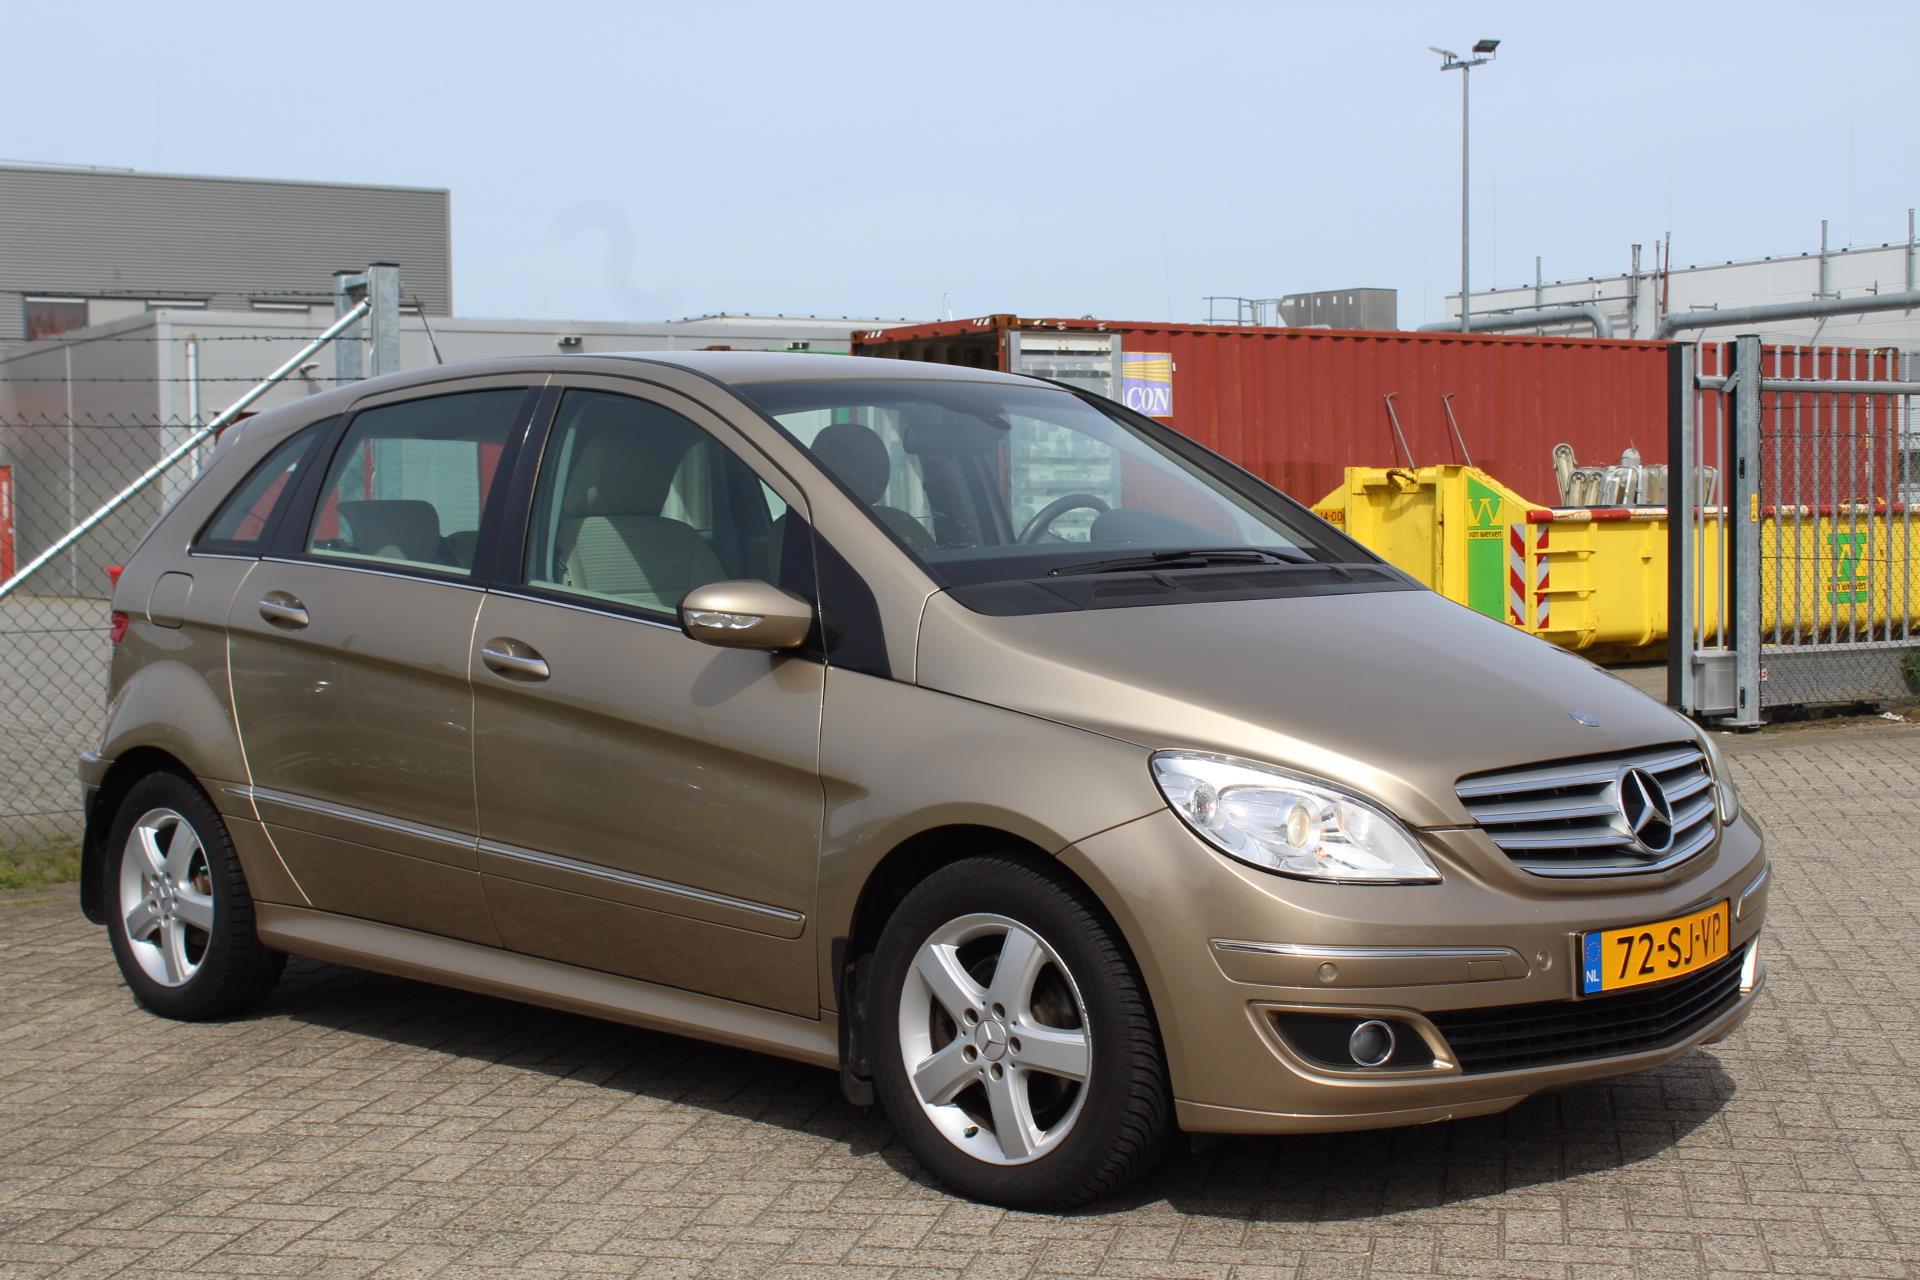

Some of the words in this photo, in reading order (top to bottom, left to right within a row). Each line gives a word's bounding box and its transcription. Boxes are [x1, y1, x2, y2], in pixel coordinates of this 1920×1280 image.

[1122, 386, 1170, 411] CON
[1617, 912, 1721, 979] 72-SJ-VP
[1586, 969, 1600, 983] NL
